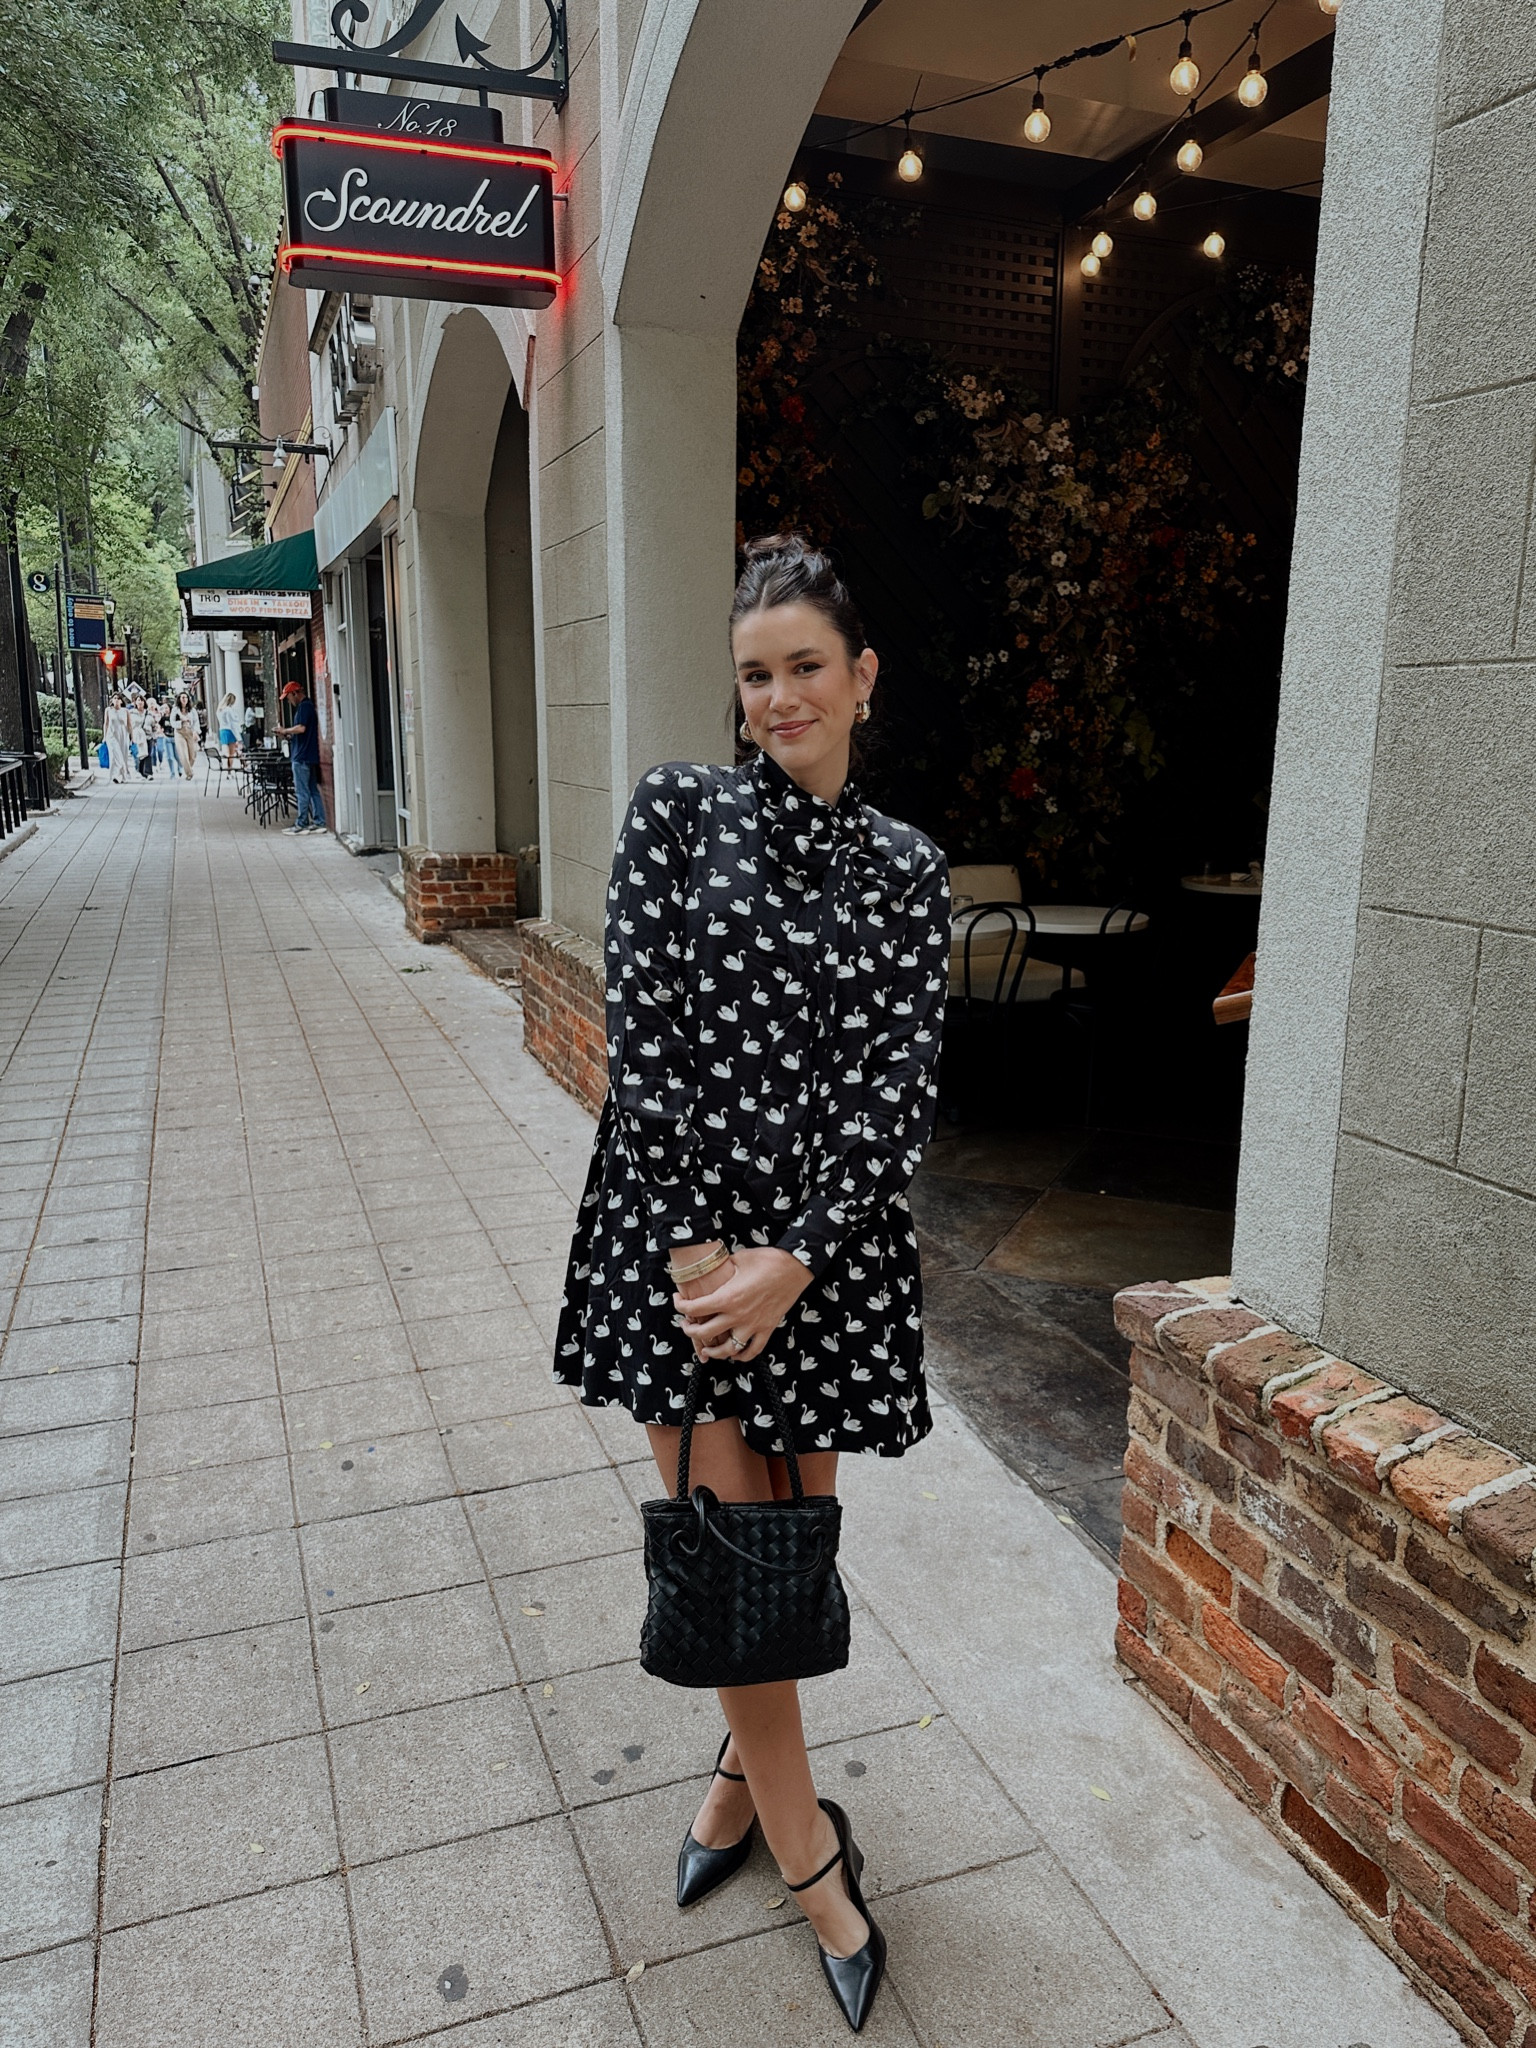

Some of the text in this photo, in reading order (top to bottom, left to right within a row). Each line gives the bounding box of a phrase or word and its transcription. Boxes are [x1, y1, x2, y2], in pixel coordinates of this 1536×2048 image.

[303, 167, 541, 239] Scoundrel
[66, 596, 74, 618] enjoy
[271, 599, 309, 608] TAKEOUT
[285, 608, 309, 616] PIZZA
[67, 618, 74, 627] to
